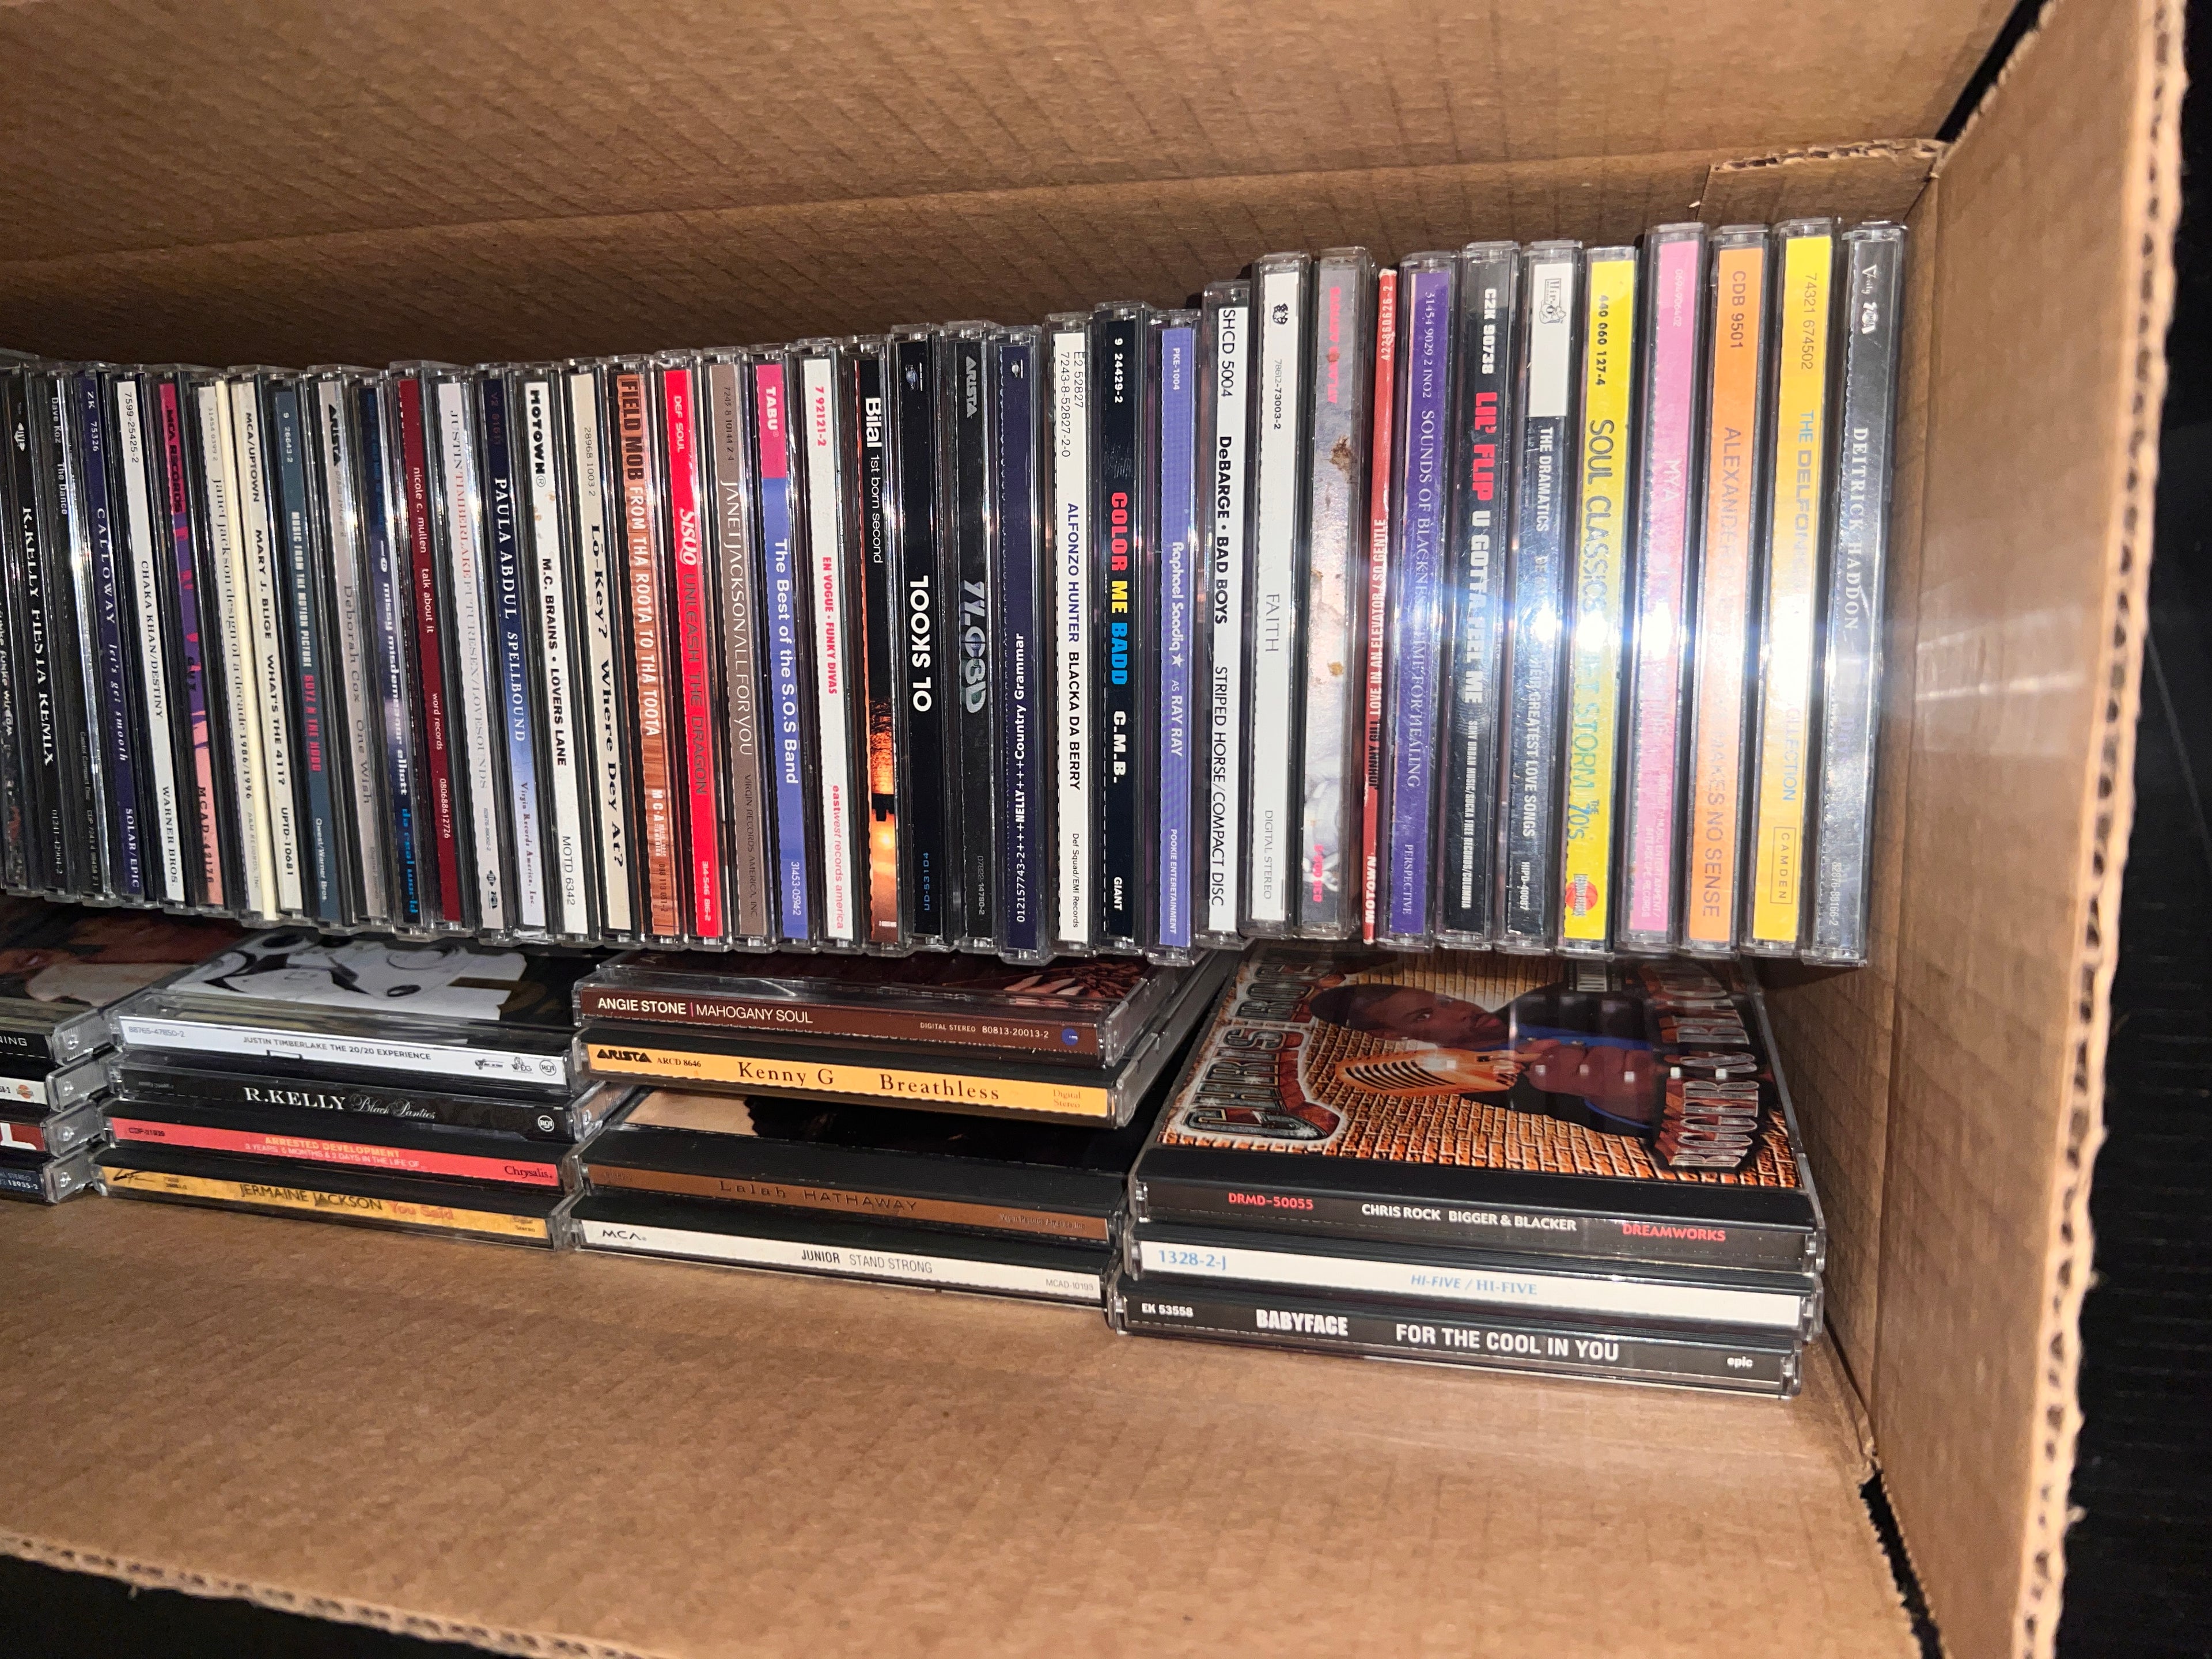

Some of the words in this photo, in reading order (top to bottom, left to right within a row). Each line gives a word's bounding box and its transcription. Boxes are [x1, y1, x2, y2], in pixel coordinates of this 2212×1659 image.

[1732, 270, 1745, 306] CDB
[1803, 273, 1816, 313] 74321
[1221, 309, 1236, 354] SHCD
[1596, 323, 1607, 344] 060
[1074, 351, 1084, 367] E2
[1219, 360, 1234, 397] 5004
[621, 381, 639, 430] FIELD
[965, 356, 976, 418] ARISTA
[1060, 352, 1070, 457] 7243-8-52827-2-0
[1074, 371, 1084, 408] 52827
[51, 397, 59, 422] Dave
[865, 398, 881, 447] Bilal
[449, 410, 462, 469] JUSTIN
[624, 437, 643, 480] MOB
[1418, 411, 1434, 483] SOUNDS
[1539, 427, 1552, 452] THE
[1586, 419, 1614, 484] SOUL
[169, 445, 182, 513] RECORDS
[413, 467, 423, 499] nicole
[870, 477, 881, 509] born
[1217, 436, 1232, 519] DeBARGE
[1472, 444, 1494, 501] FLIP
[1849, 427, 1868, 529] DEITRICK
[495, 478, 509, 546] PAULA
[629, 487, 646, 529] FROM
[719, 481, 740, 540] JANET
[1416, 488, 1431, 512] OF
[291, 512, 301, 541] MUSIC
[417, 517, 427, 553] mullen
[455, 472, 471, 578] TIMBERLAKE
[872, 513, 882, 563] second
[1067, 503, 1078, 575] ALFONZO
[1110, 492, 1127, 571] COLOR
[255, 529, 265, 574] MARY
[293, 546, 302, 570] FROM
[328, 404, 340, 467] ARISTA
[351, 671, 361, 702] Cox
[632, 537, 647, 566] THA
[774, 539, 788, 573] The
[822, 557, 831, 571] EN
[1169, 542, 1184, 599] Raphael
[1215, 536, 1228, 573] BAD
[499, 551, 515, 619] ABDUL
[635, 574, 652, 623] ROOTA
[723, 542, 744, 631] JACKSON
[776, 579, 789, 620] Best
[823, 575, 833, 612] VOGUE
[1111, 581, 1127, 613] ME
[1213, 579, 1228, 624] BOYS
[1843, 542, 1861, 630] HADDON
[261, 598, 271, 639] BLIGE
[423, 592, 433, 622] about
[909, 575, 930, 667] SKOOL
[1067, 581, 1080, 642] HUNTER
[1264, 593, 1279, 652] FAITH
[96, 507, 115, 624] CALLOWAY
[115, 711, 127, 761] smooth
[639, 629, 653, 648] TO
[778, 626, 794, 643] of
[1111, 622, 1127, 685] BADD
[215, 523, 233, 584] jackson
[240, 734, 251, 799] 1986/1996
[640, 655, 655, 683] THA
[780, 650, 793, 677] the
[827, 662, 836, 694] DIVAS
[1014, 633, 1024, 700] Grammar
[1068, 652, 1078, 711] BLACKA
[141, 561, 152, 608] CHAKA
[161, 787, 175, 844] WARNER
[267, 655, 278, 713] WHAT'S
[550, 669, 563, 724] LOVERS
[689, 672, 701, 707] THE
[736, 675, 749, 712] FOR
[912, 677, 931, 711] OL
[1214, 666, 1228, 725] STRIPED
[1369, 688, 1380, 715] LOVE
[1463, 671, 1482, 703] ME
[38, 692, 53, 766] REMIX
[643, 691, 658, 736] TOOTA
[1069, 715, 1078, 737] DA
[1170, 695, 1183, 725] RAY
[272, 719, 281, 744] THE
[555, 730, 566, 766] LANE
[600, 659, 614, 752] Where
[607, 763, 618, 811] Dey
[1170, 728, 1181, 756] RAY
[691, 716, 706, 794] DRAGON
[784, 740, 798, 783] Band
[1069, 741, 1079, 790] BERRY
[1523, 760, 1537, 791] LOVE
[1521, 795, 1536, 837] SONGS
[833, 840, 842, 882] records
[1169, 829, 1177, 859] POOKIE
[1263, 857, 1273, 899] STEREO
[1702, 848, 1720, 916] SENSE
[1777, 832, 1789, 899] CAMDEN
[835, 885, 844, 929] america
[1112, 877, 1122, 910] GIANT
[1210, 872, 1224, 906] DISC
[1363, 856, 1377, 923] MOTOWN
[1571, 897, 1587, 916] RECORDS
[598, 997, 639, 1011] ANGIE
[641, 1000, 686, 1014] STONE
[696, 1004, 773, 1021] MAHOGANY
[776, 1010, 813, 1024] SOUL
[921, 1022, 946, 1030] DIGITAL
[949, 1024, 976, 1032] STEREO
[274, 1039, 327, 1050] TIMBERLAKE
[377, 1048, 431, 1060] EXPERIENCE
[243, 1088, 346, 1109] R.KELLY
[350, 1094, 389, 1114] Black
[738, 1062, 806, 1086] Kenny
[817, 1068, 834, 1085] G
[880, 1074, 999, 1099] Breathless
[1053, 1089, 1081, 1100] Digital
[1053, 1099, 1080, 1109] Stereo
[265, 1137, 319, 1149] ARRESTED
[323, 1142, 400, 1157] DEVELOPMENT
[240, 1183, 308, 1201] JERMAINE
[313, 1192, 382, 1210] JACKSON
[720, 1180, 786, 1198] Lalah
[804, 1189, 917, 1211] HATHAWAY
[1228, 1192, 1313, 1209] DRMD-50055
[1362, 1203, 1401, 1218] CHRIS
[1403, 1206, 1440, 1221] ROCK
[1449, 1211, 1498, 1225] BIGGER
[1501, 1215, 1512, 1227] &
[1514, 1215, 1576, 1232] BLACKER
[1622, 1224, 1726, 1241] DREAMWORKS
[801, 1249, 840, 1264] JUNIOR
[849, 1255, 885, 1268] STAND
[888, 1257, 933, 1274] STRONG
[1158, 1249, 1226, 1270] 1328-2-J
[1477, 1279, 1537, 1295] HI-FIVE
[1142, 1303, 1156, 1314] EK
[1159, 1304, 1193, 1317] 53558
[1256, 1309, 1347, 1336] BABYFACE
[1396, 1324, 1435, 1344] FOR
[1441, 1327, 1480, 1349] THE
[1486, 1332, 1541, 1354] COOL
[1548, 1337, 1568, 1357] IN
[1575, 1340, 1619, 1362] YOU
